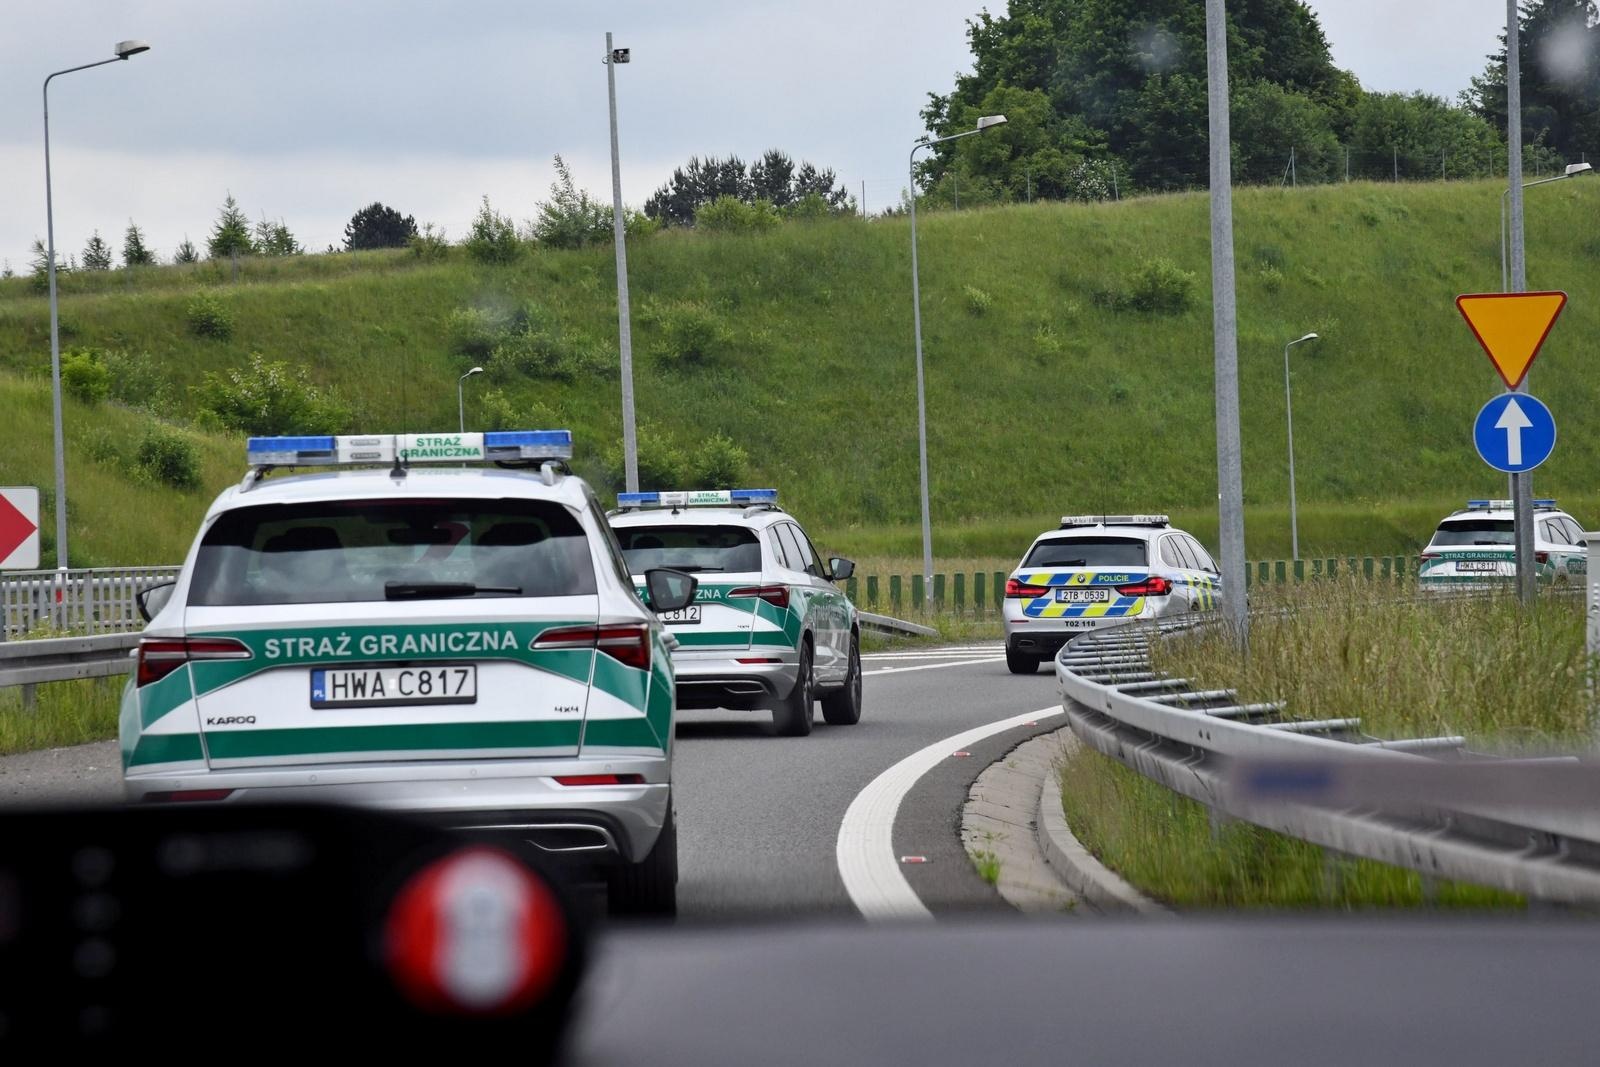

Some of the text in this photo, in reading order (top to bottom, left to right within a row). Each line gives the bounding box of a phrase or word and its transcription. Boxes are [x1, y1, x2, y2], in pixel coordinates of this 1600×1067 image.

[417, 436, 461, 447] STRAŻ
[400, 448, 481, 458] GRANICZNA
[1098, 574, 1129, 582] POLICIE
[1063, 591, 1105, 600] 2TB 0539
[663, 607, 697, 620] C812
[264, 630, 519, 658] STRAŻ GRANICZNA
[331, 669, 469, 699] HWA C817
[313, 689, 325, 698] PL
[206, 715, 256, 725] KAROQ
